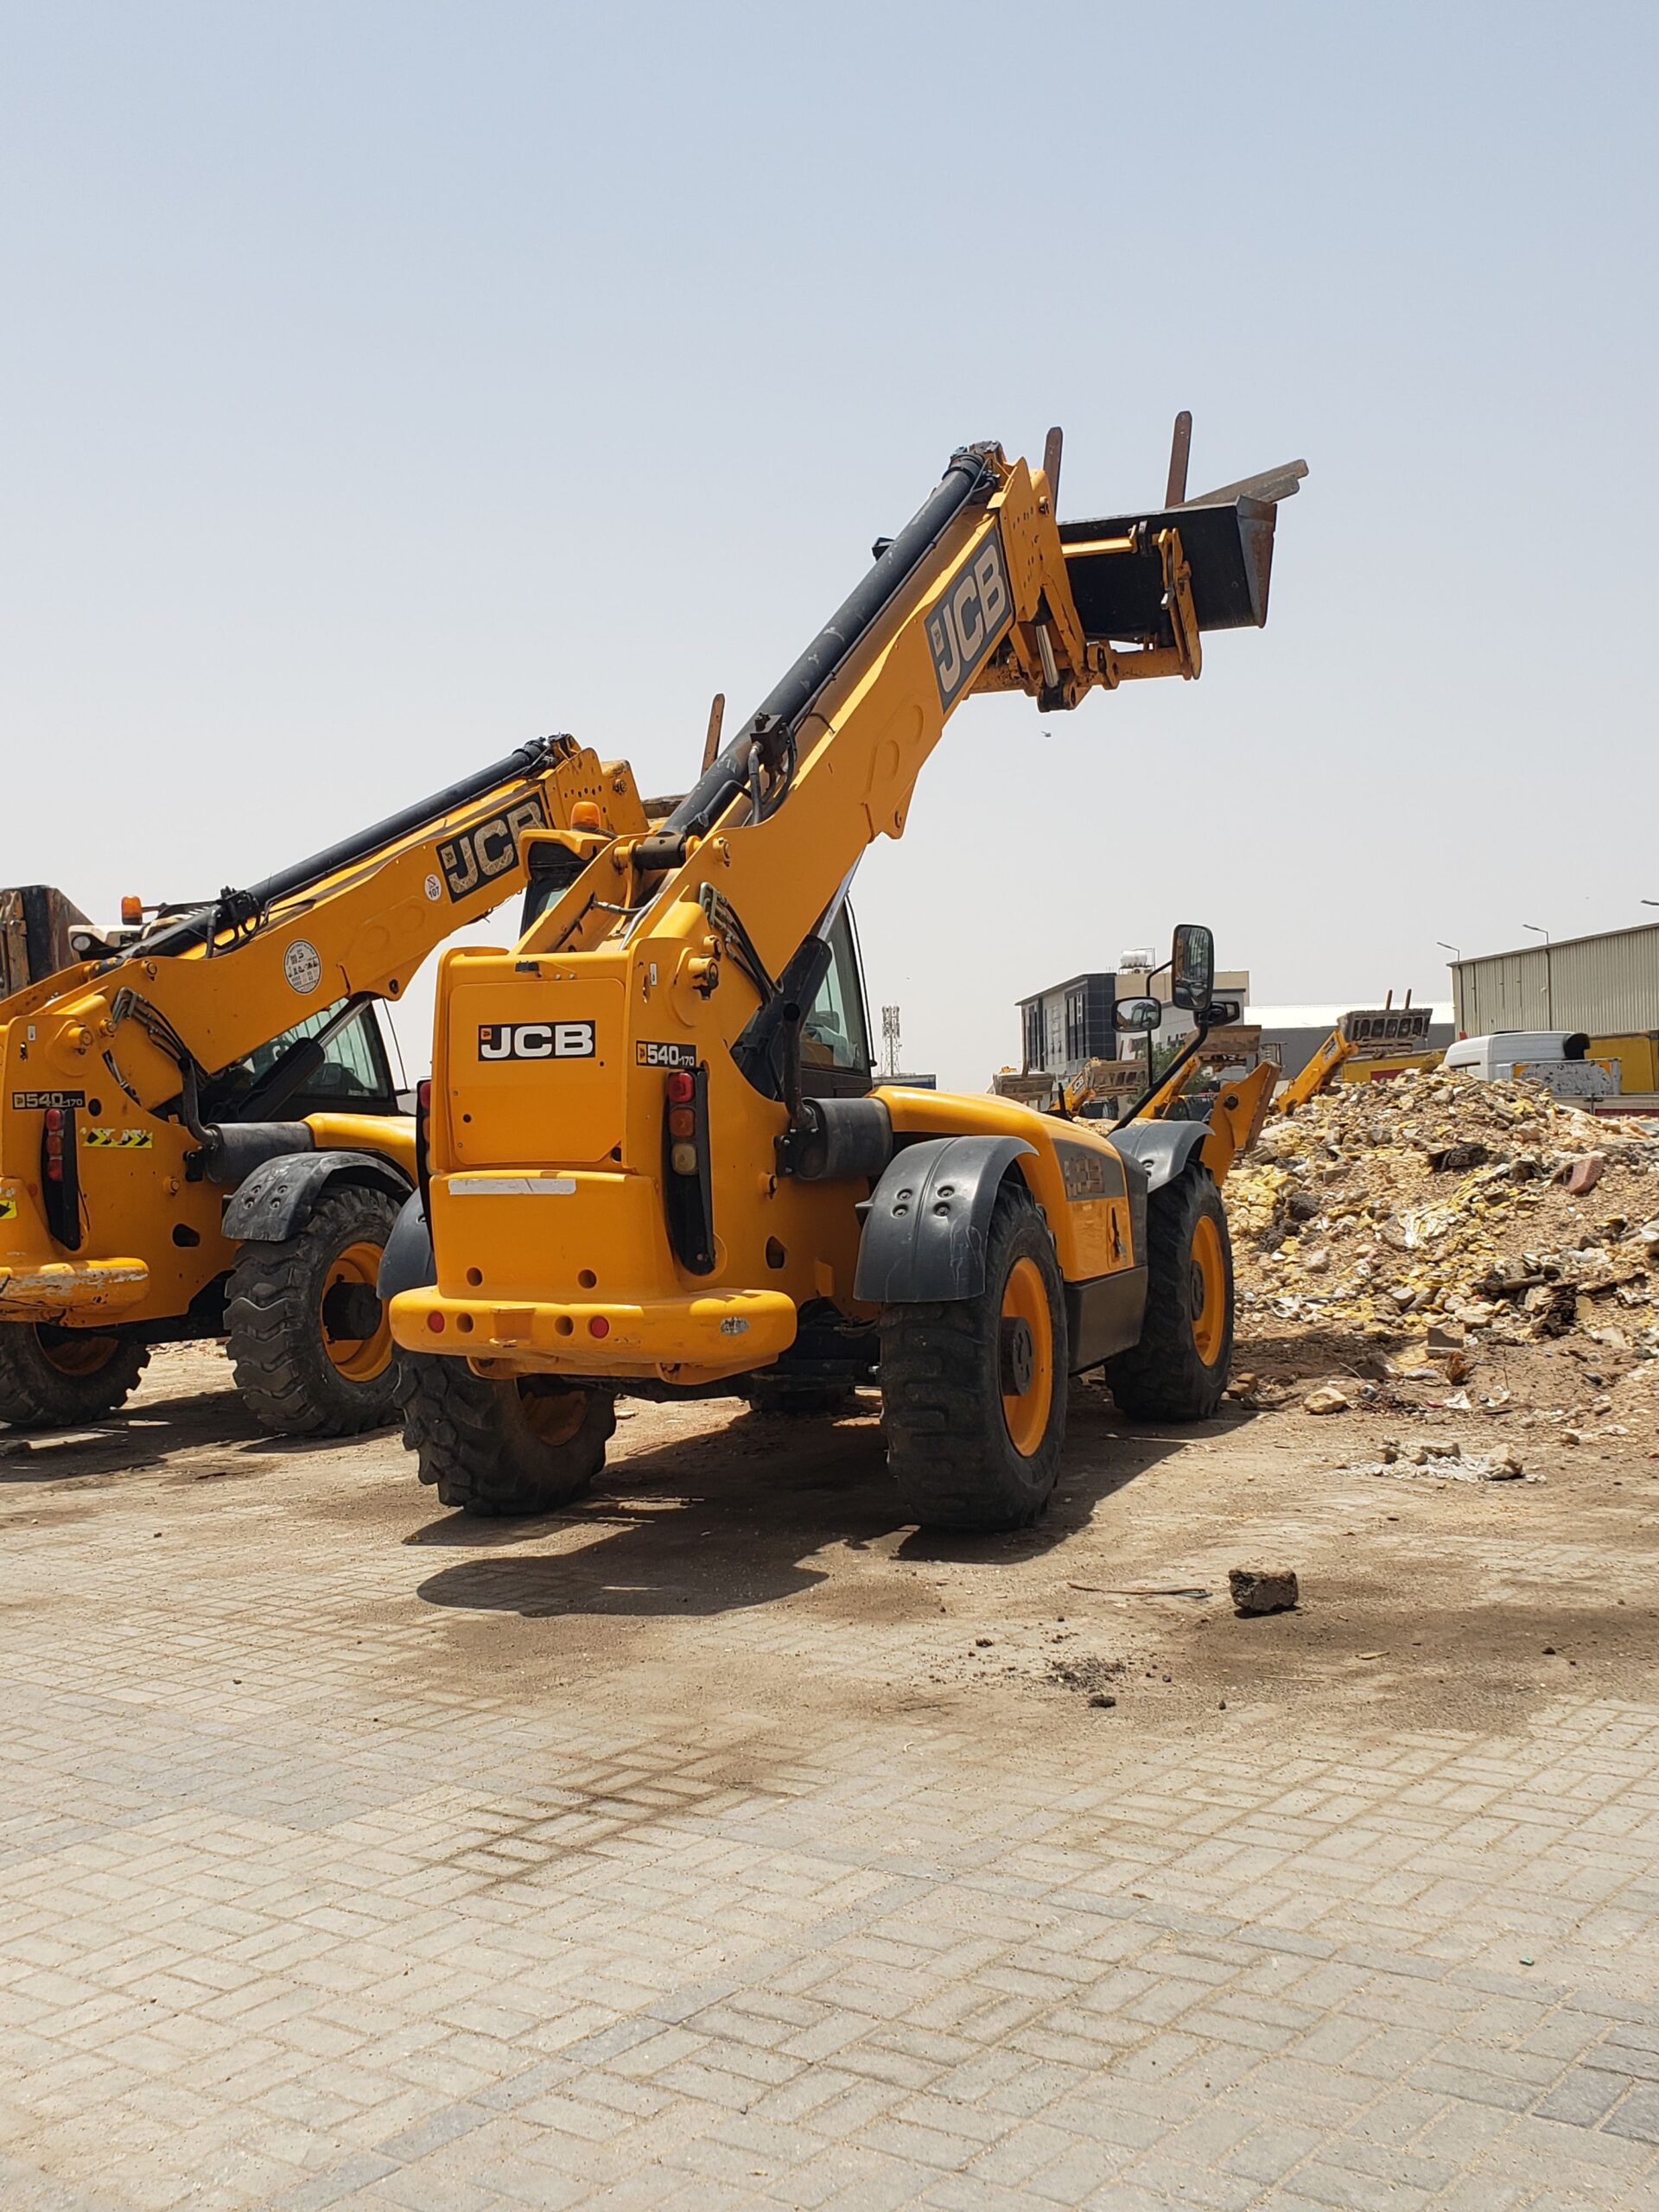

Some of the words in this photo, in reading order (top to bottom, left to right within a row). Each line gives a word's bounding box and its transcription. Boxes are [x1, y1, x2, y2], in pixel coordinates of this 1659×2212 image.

[939, 544, 1006, 692] JCB
[429, 886, 439, 898] 107
[481, 1024, 594, 1059] JCB
